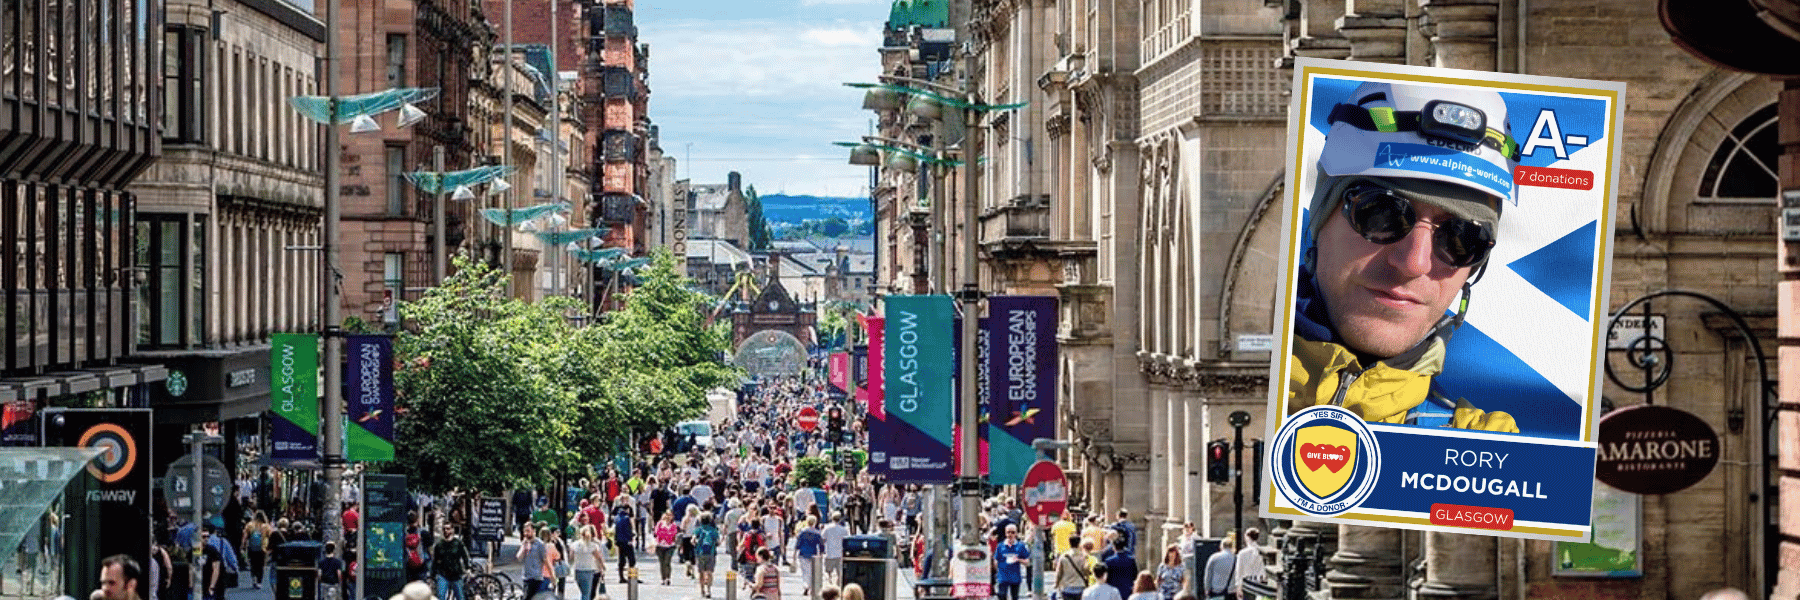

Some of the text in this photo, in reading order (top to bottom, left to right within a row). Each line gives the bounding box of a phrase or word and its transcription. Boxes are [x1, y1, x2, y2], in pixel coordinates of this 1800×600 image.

[1410, 154, 1511, 189] www.alpine-world.com
[281, 343, 295, 413] GLASGOW
[360, 343, 372, 405] EUROPEAN
[899, 310, 918, 413] GLASGOW
[1008, 309, 1025, 401] EUROPEAN
[1024, 309, 1037, 401] CHAMPIONSHIPS
[1597, 440, 1712, 461] AMARONE
